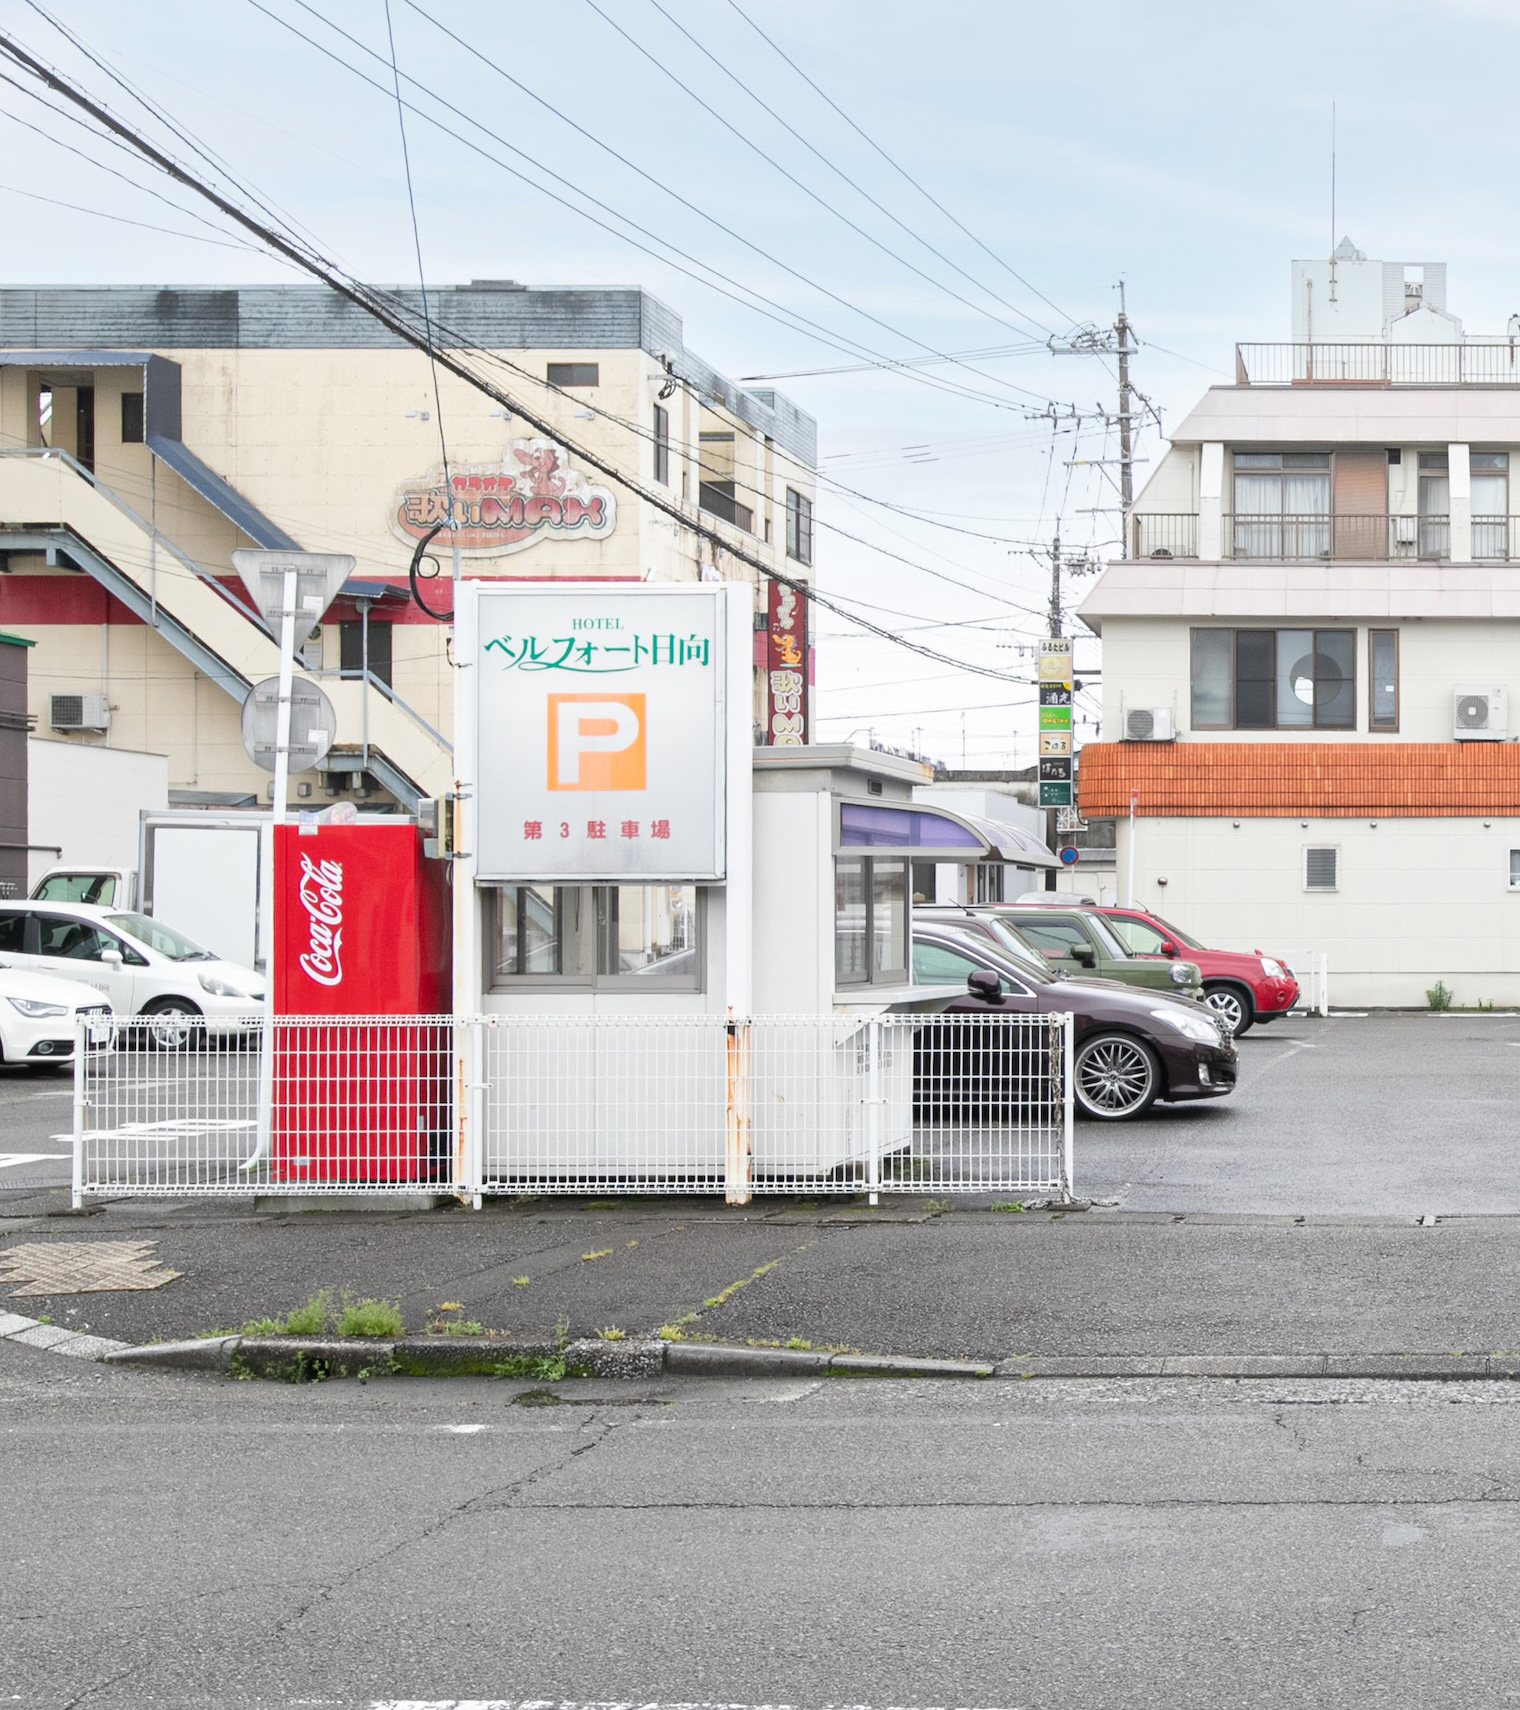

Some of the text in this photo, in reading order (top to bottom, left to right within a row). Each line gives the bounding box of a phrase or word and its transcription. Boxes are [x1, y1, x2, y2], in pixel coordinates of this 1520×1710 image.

[452, 476, 514, 491] カラオケ
[572, 617, 624, 630] HOTEL
[483, 633, 710, 673] ベルフォート日向
[557, 702, 640, 784] P
[299, 851, 343, 987] Coca-Cola
